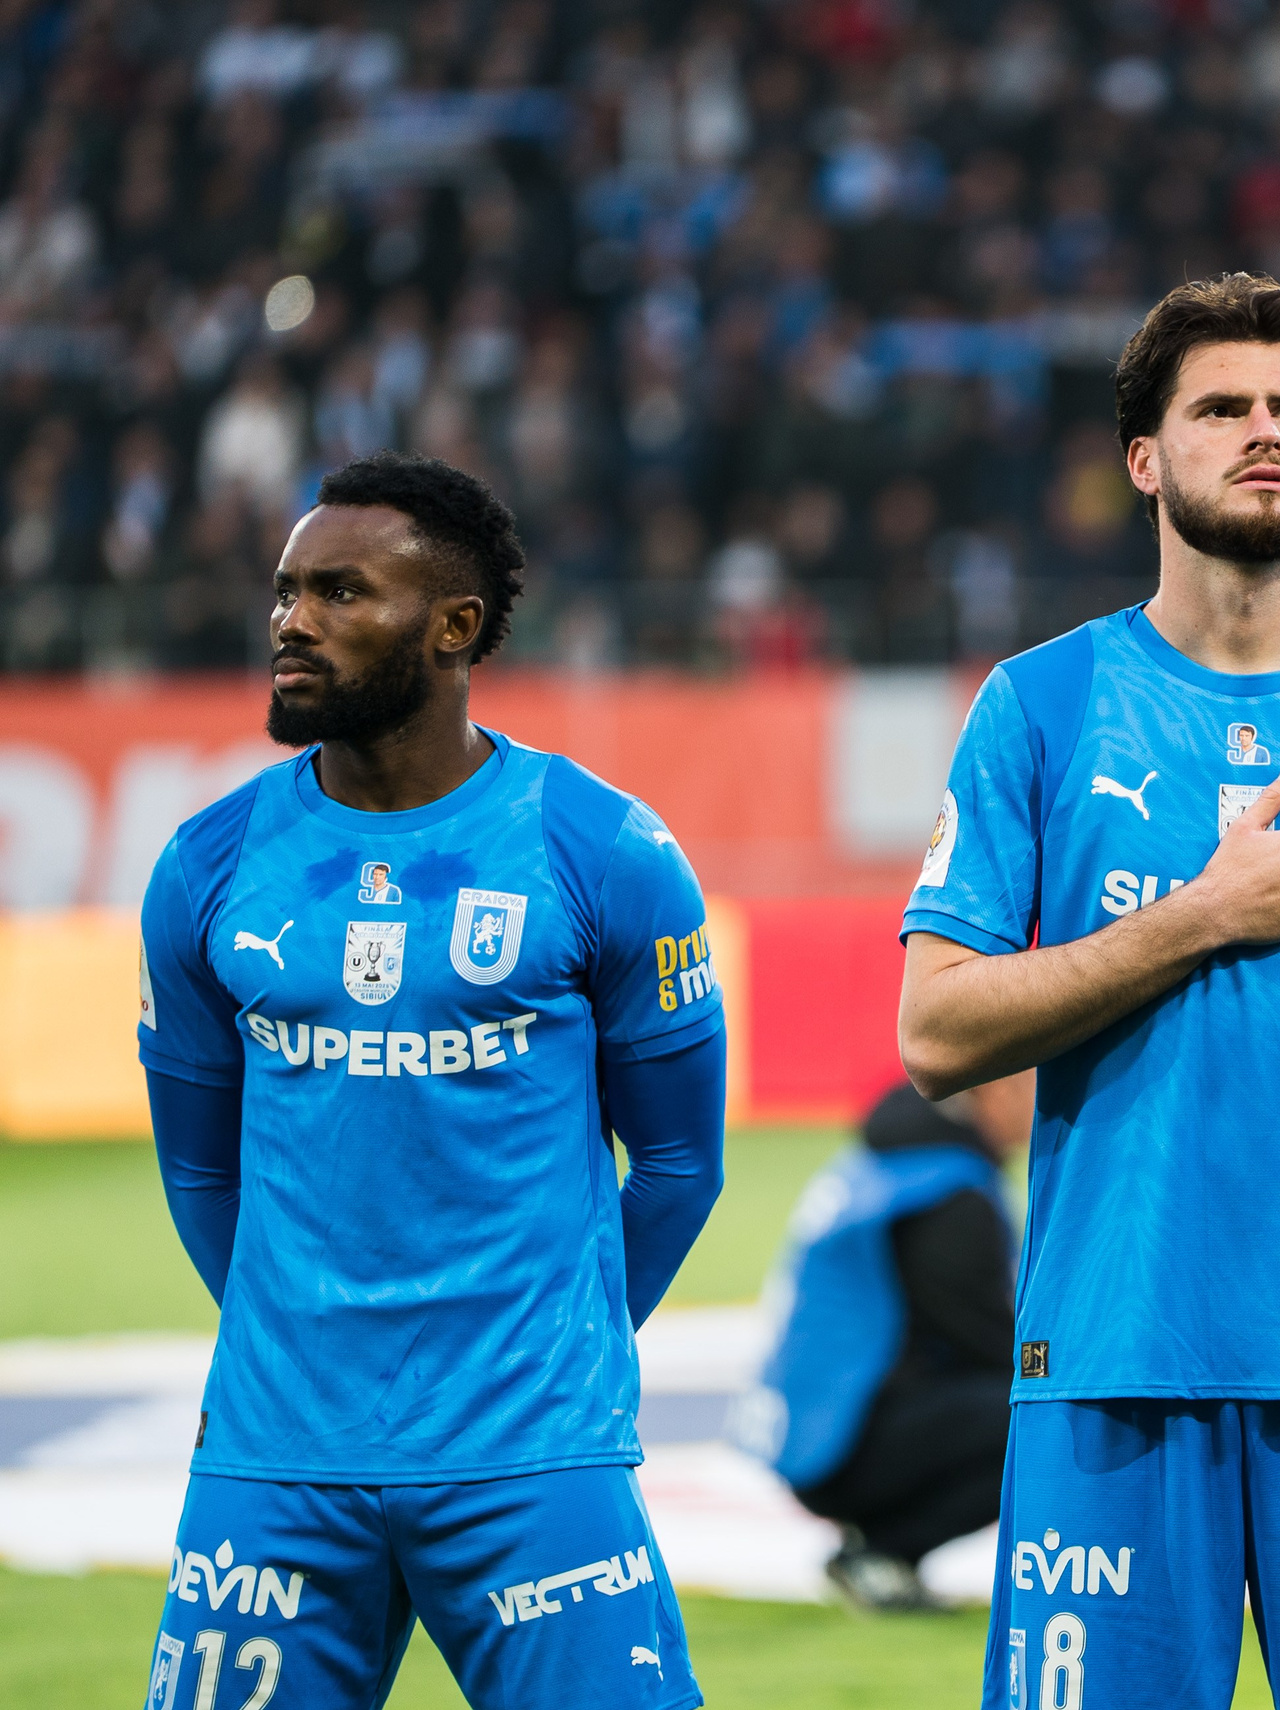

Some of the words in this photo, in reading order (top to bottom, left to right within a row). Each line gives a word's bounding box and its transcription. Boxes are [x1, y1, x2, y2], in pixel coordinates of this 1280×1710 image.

[459, 890, 526, 909] CRAIOVA
[353, 957, 361, 967] U
[655, 921, 712, 979] Drin
[360, 992, 383, 1000] SIBIU
[658, 978, 678, 1012] &
[246, 1012, 537, 1077] SUPERBET
[167, 1541, 305, 1620] DEVIN
[487, 1545, 655, 1627] VECTRUM
[1011, 1535, 1131, 1596] EVIN
[192, 1628, 284, 1710] 12
[1039, 1611, 1087, 1710] 8
